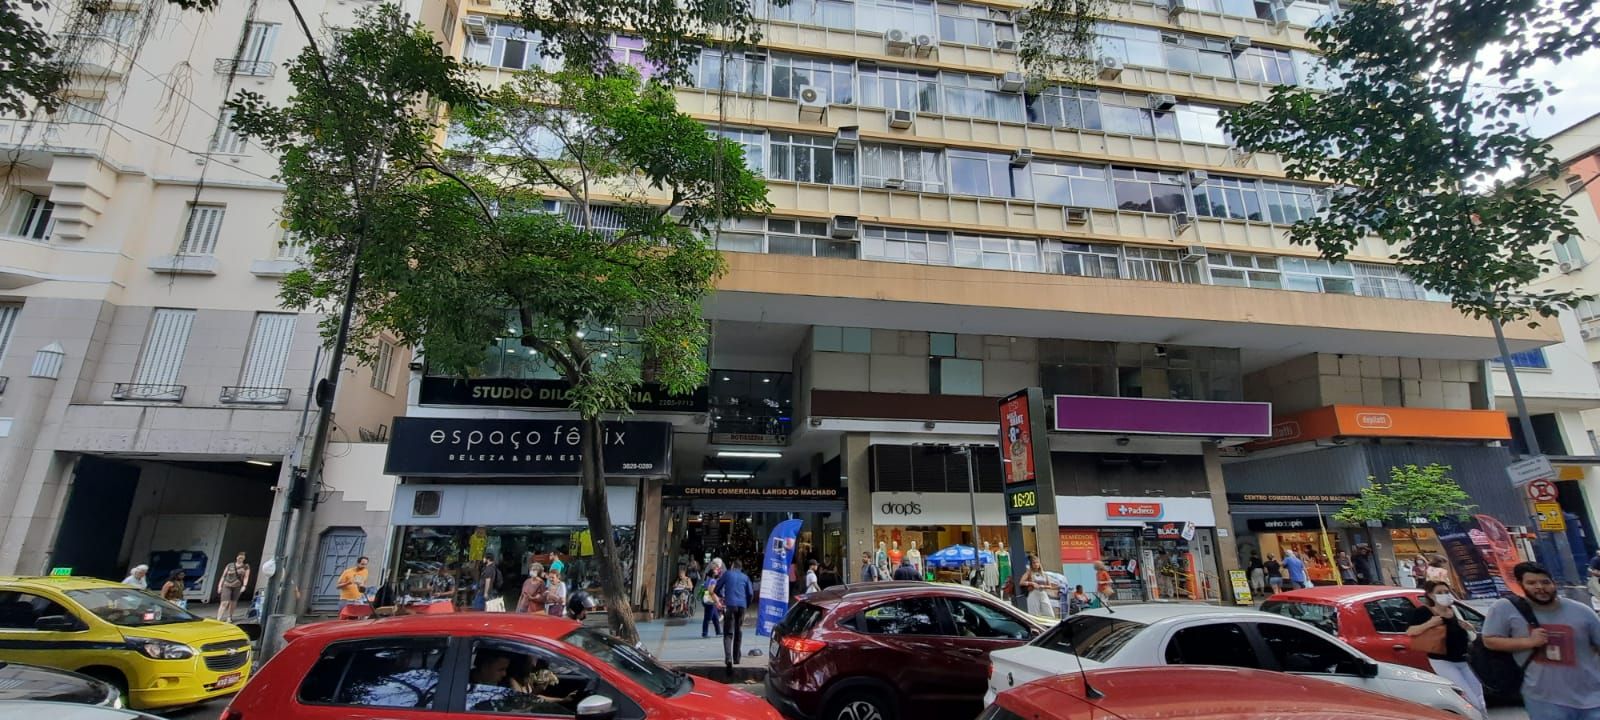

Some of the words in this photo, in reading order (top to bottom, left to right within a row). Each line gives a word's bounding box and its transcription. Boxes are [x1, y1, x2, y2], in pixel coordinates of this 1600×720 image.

[472, 386, 533, 400] STUDIO
[430, 429, 541, 451] espaço
[553, 425, 626, 446] fêix
[525, 454, 553, 462] BEM
[685, 487, 716, 495] CENTRO
[717, 487, 761, 496] COMERCIAL
[762, 488, 788, 496] LARGO
[1013, 492, 1035, 507] 16:20
[1127, 507, 1155, 515] Pacheco
